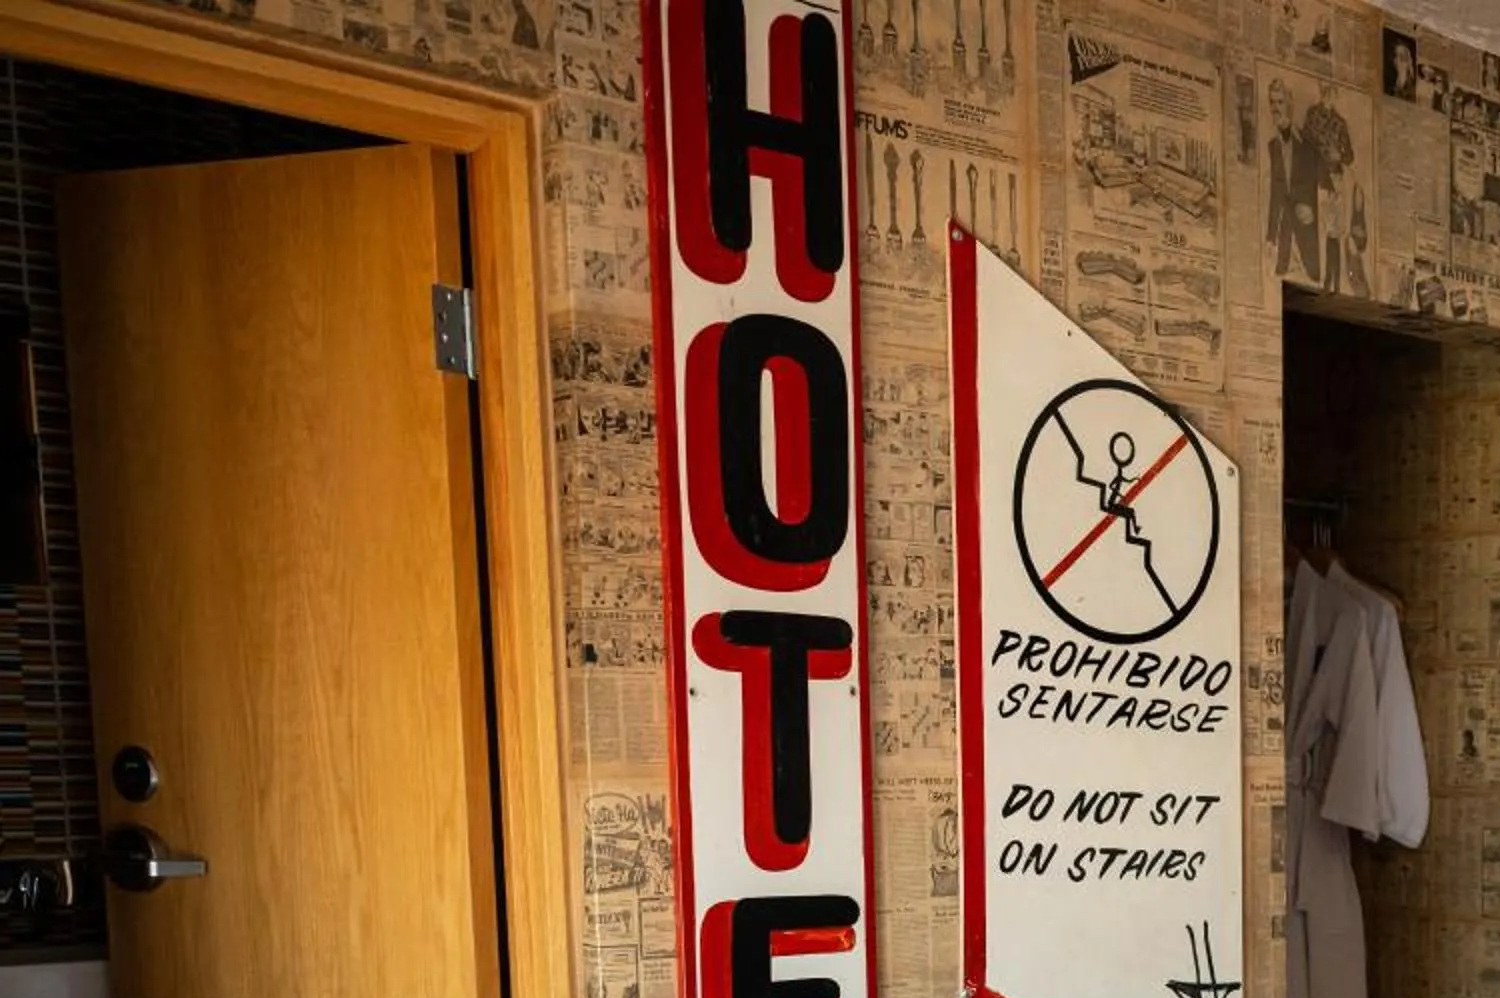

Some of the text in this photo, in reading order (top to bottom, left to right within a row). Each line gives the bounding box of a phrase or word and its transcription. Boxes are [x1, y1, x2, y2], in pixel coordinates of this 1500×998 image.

[991, 629, 1232, 696] PROHIBIDO
[998, 683, 1229, 733] SENTARSE
[1001, 784, 1055, 822] DO
[1063, 790, 1143, 824] NOT
[1150, 793, 1221, 826] SIT
[999, 840, 1205, 882] ON STAIRS
